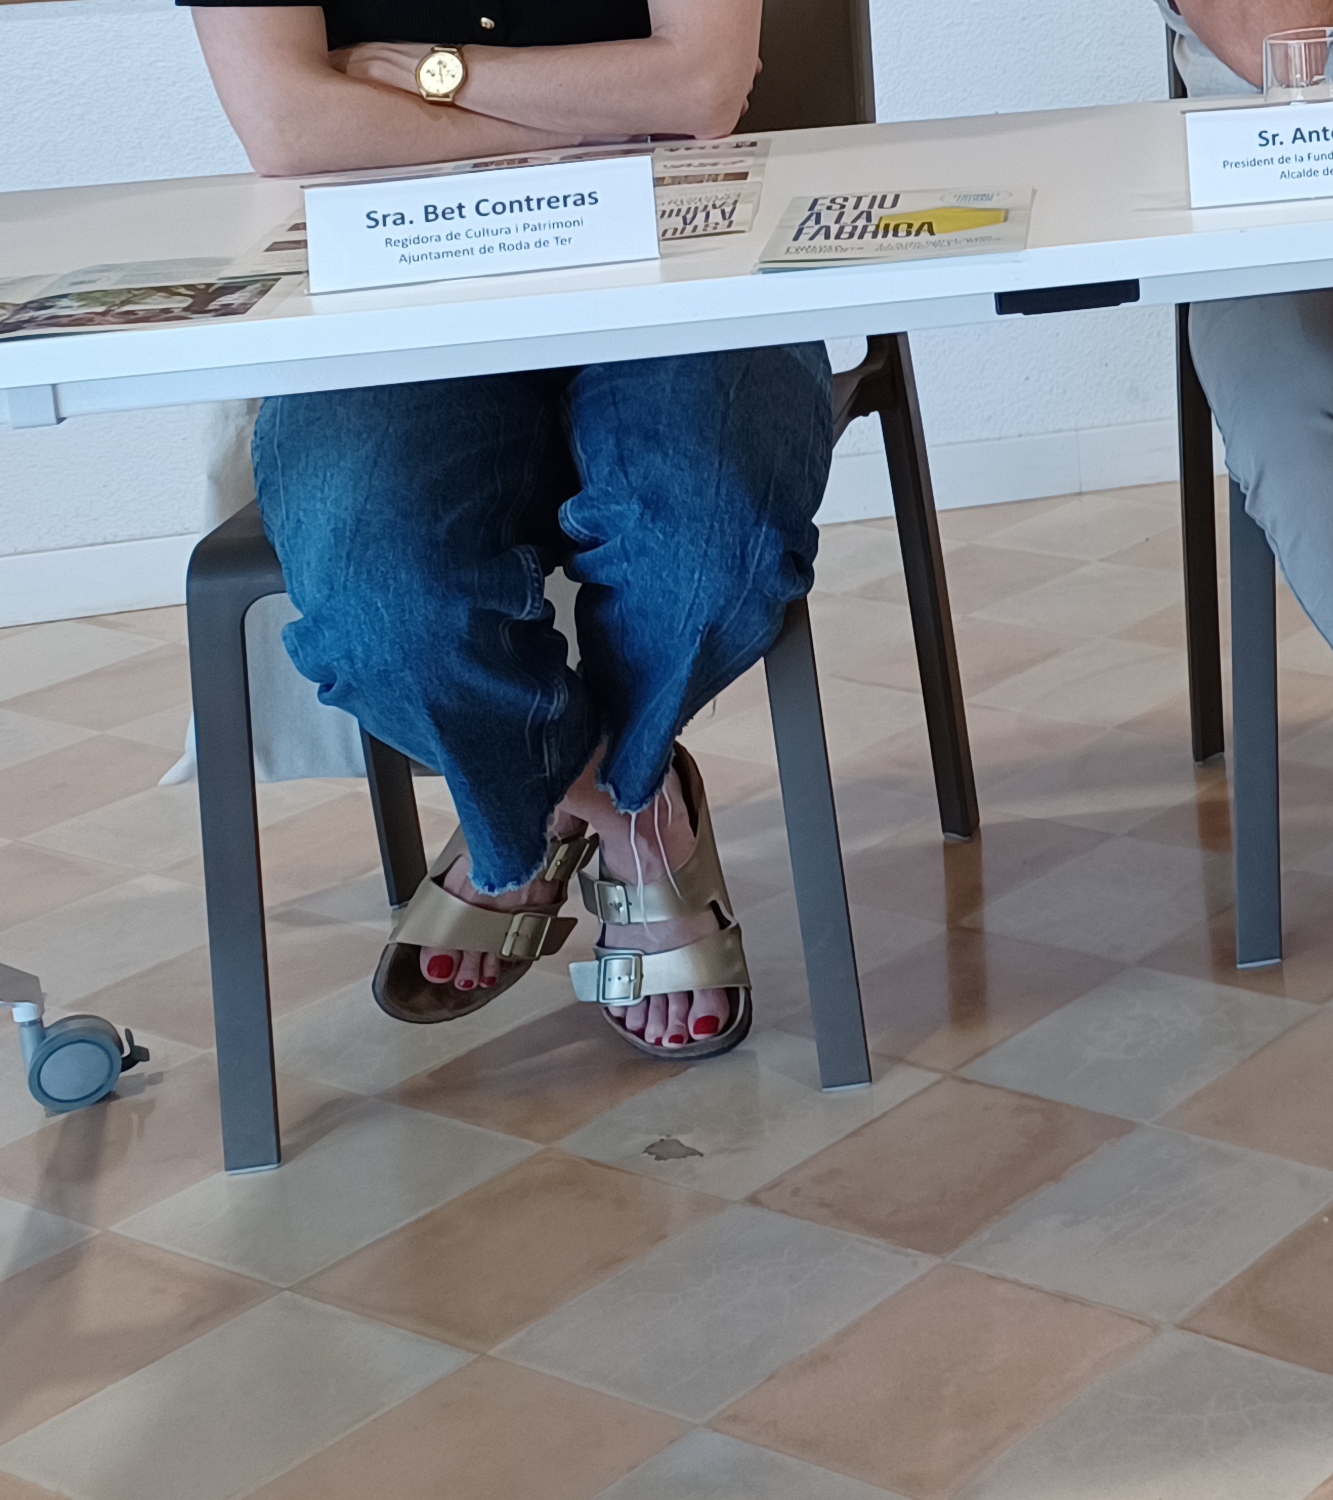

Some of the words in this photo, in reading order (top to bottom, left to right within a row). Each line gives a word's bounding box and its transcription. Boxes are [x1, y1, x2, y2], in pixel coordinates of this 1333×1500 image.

[1257, 130, 1284, 148] Sr.
[1222, 156, 1275, 170] President
[1277, 154, 1292, 165] de
[1294, 153, 1303, 163] la
[1279, 168, 1319, 180] Alcalde
[365, 211, 414, 229] Sra.
[424, 201, 467, 224] Bet
[474, 190, 599, 217] Contreras
[807, 193, 900, 212] ESTIU
[385, 232, 442, 249] Regidora
[445, 230, 461, 241] de
[465, 224, 512, 239] Cultura
[515, 223, 519, 233] i
[523, 216, 584, 232] Patrimoni
[398, 247, 475, 265] Ajuntament
[478, 243, 495, 255] de
[498, 240, 530, 253] Roda
[534, 238, 550, 249] de
[554, 236, 573, 246] Ter
